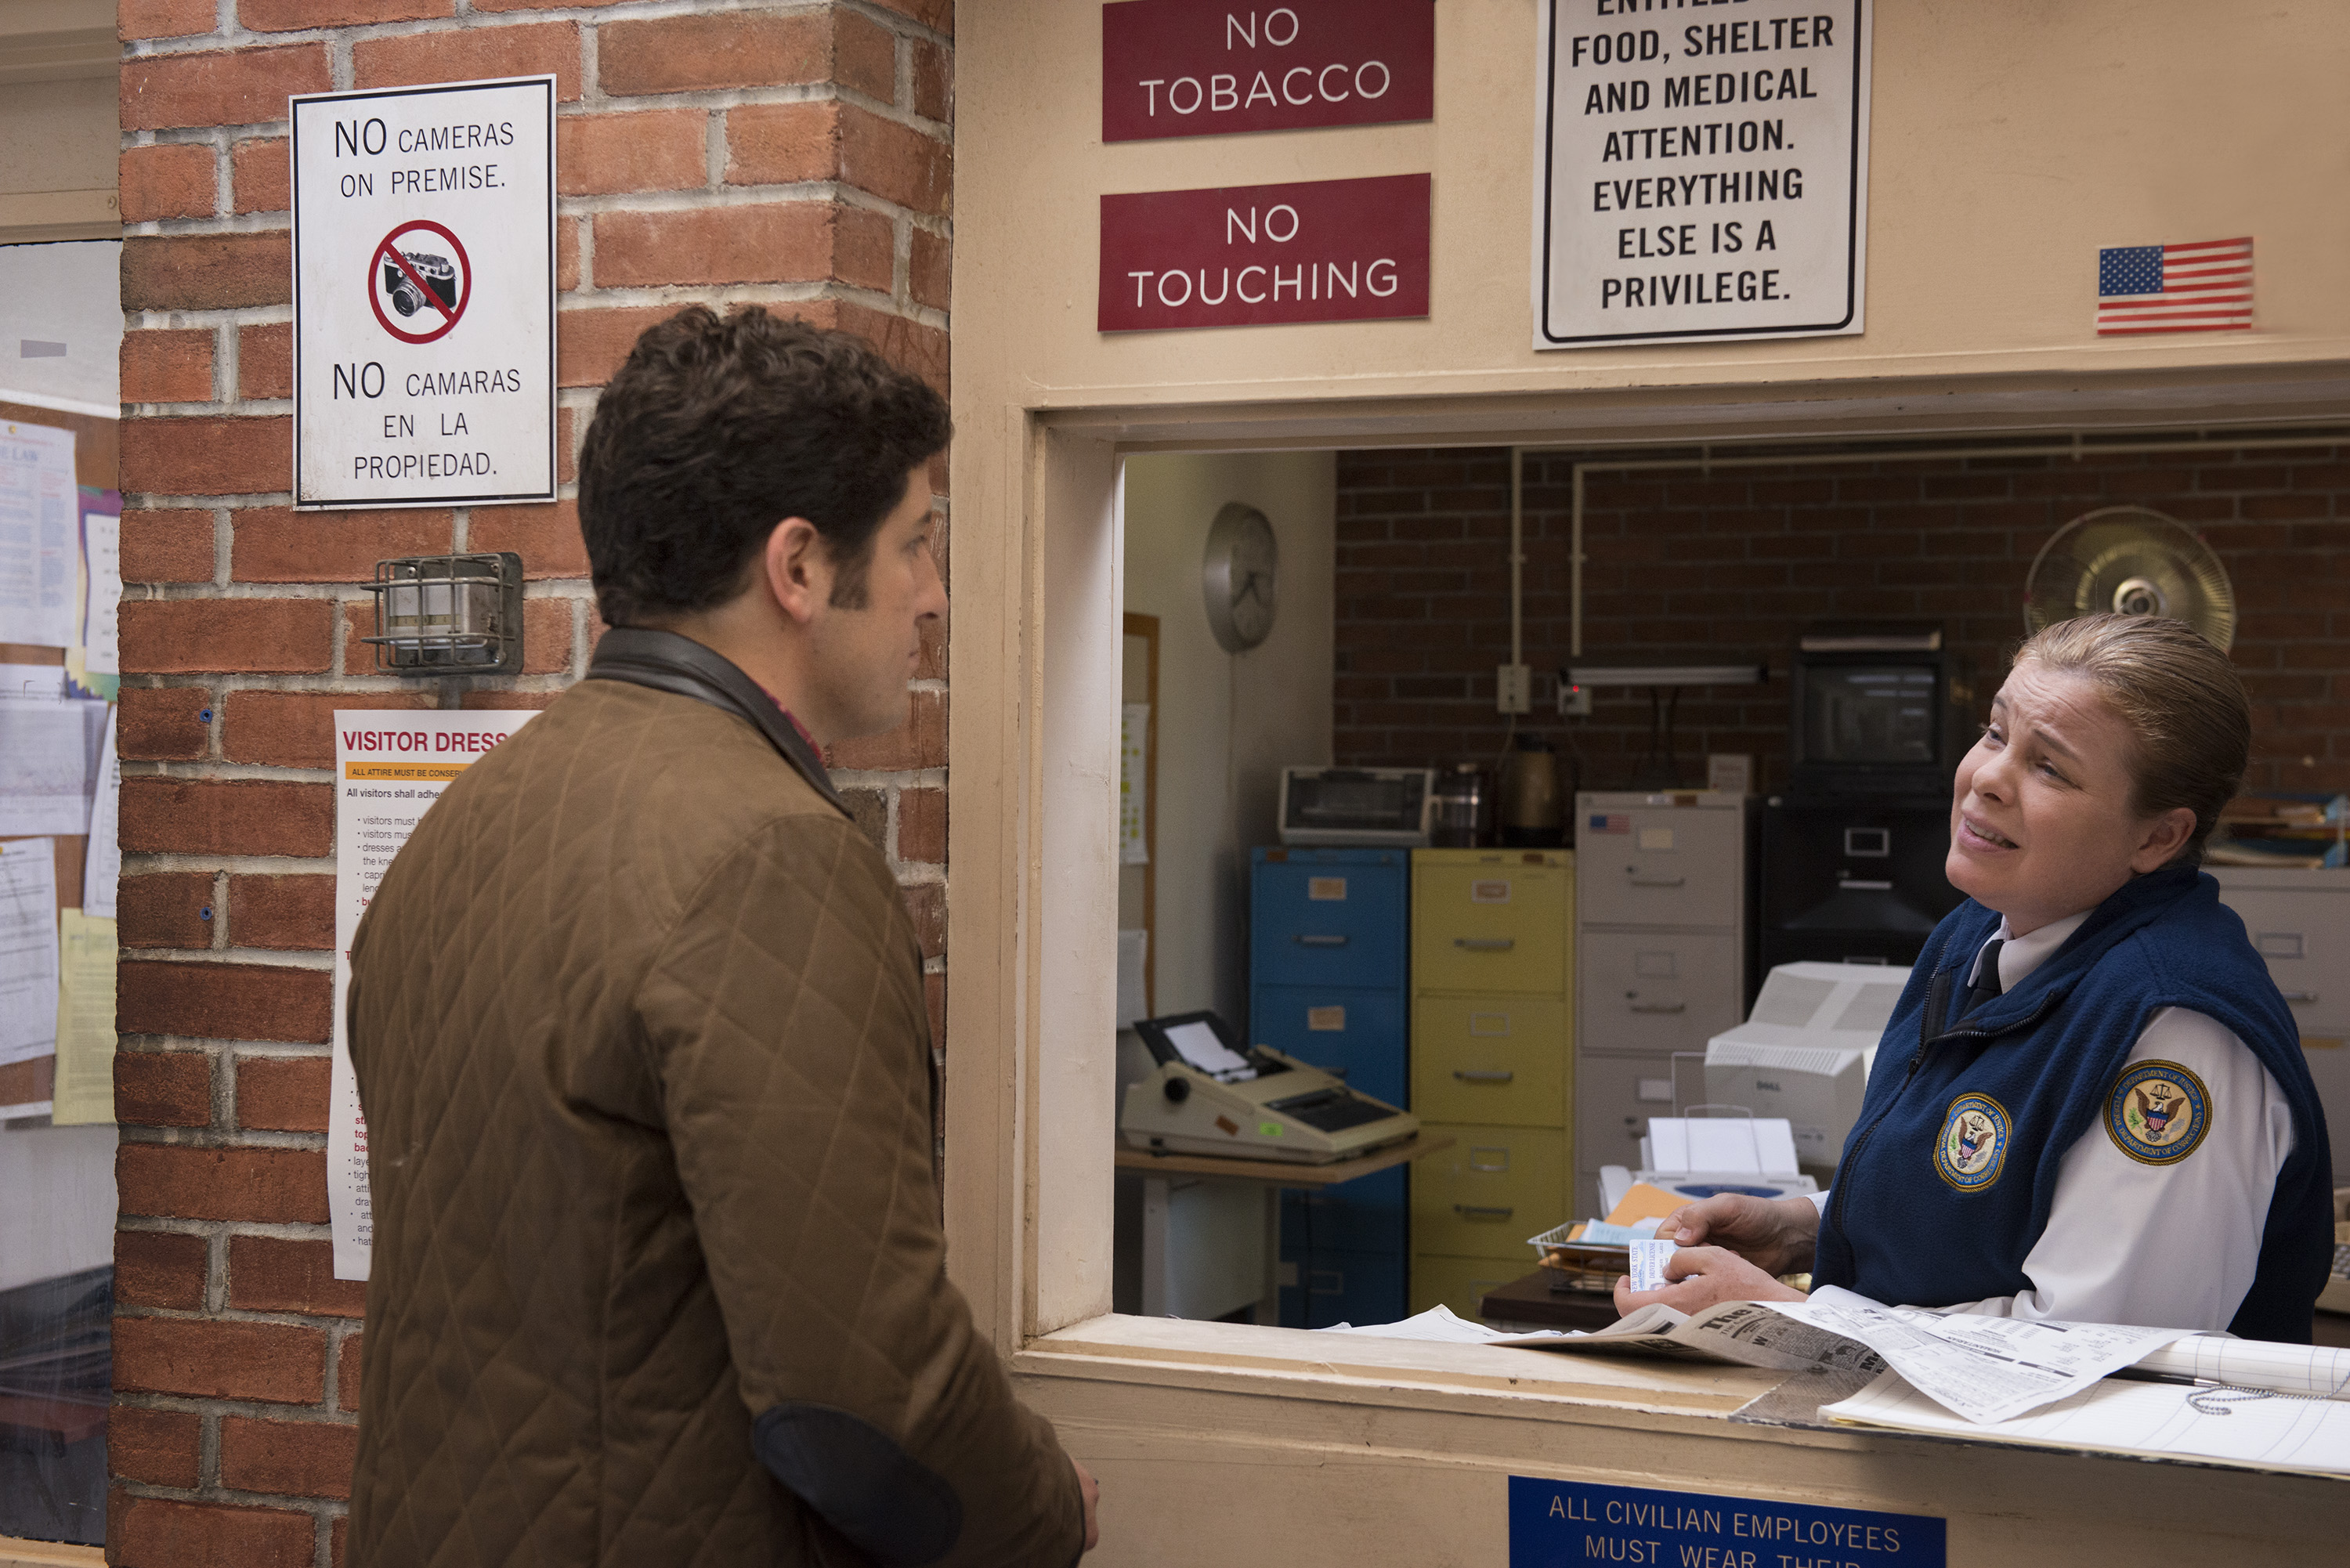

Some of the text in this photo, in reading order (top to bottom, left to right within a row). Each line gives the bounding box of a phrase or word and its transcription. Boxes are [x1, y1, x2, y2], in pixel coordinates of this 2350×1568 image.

[1227, 9, 1298, 50] NO
[1573, 16, 1833, 67] FOOD, SHELTER
[1140, 61, 1390, 116] TOBACCO
[1585, 67, 1817, 114] AND MEDICAL
[336, 118, 513, 157] NO CAMERAS
[1603, 119, 1793, 162] ATTENTION.
[342, 164, 506, 197] ON PREMISE.
[1594, 168, 1802, 211] EVERYTHING
[1227, 205, 1299, 244] NO
[1619, 220, 1776, 258] ELSE IS A
[1128, 259, 1397, 307] TOUCHING
[1603, 269, 1789, 309] PRIVILEGE.
[334, 362, 520, 399] NO CAMARAS
[385, 413, 468, 438] EN LA
[356, 453, 497, 479] PROPIEDAD.
[343, 731, 428, 752] VISITOR
[347, 788, 358, 797] All
[360, 789, 392, 798] visitors
[394, 789, 415, 799] shall
[363, 815, 392, 826] visitors
[394, 818, 415, 826] must
[363, 829, 392, 839] visitors
[363, 843, 395, 853] dresses
[363, 857, 393, 865] the kne
[364, 870, 385, 881] capri
[2123, 1070, 2168, 1089] DEPARTMENT
[2178, 1078, 2199, 1100] JUSTICE
[1954, 1101, 1987, 1116] DEPARTMENT
[1992, 1115, 2005, 1139] JUSTICE
[2118, 1127, 2162, 1155] DEPARTMENT
[2172, 1112, 2202, 1151] CORRECTIONS
[353, 1156, 369, 1168] laye
[353, 1169, 370, 1181] tigh
[356, 1183, 370, 1193] atti
[1698, 1309, 1753, 1330] The
[1549, 1496, 1899, 1552] ALL CIVILIAN EMPLOYEES
[1587, 1536, 1660, 1563] MUST
[1680, 1545, 1755, 1568] WEAR
